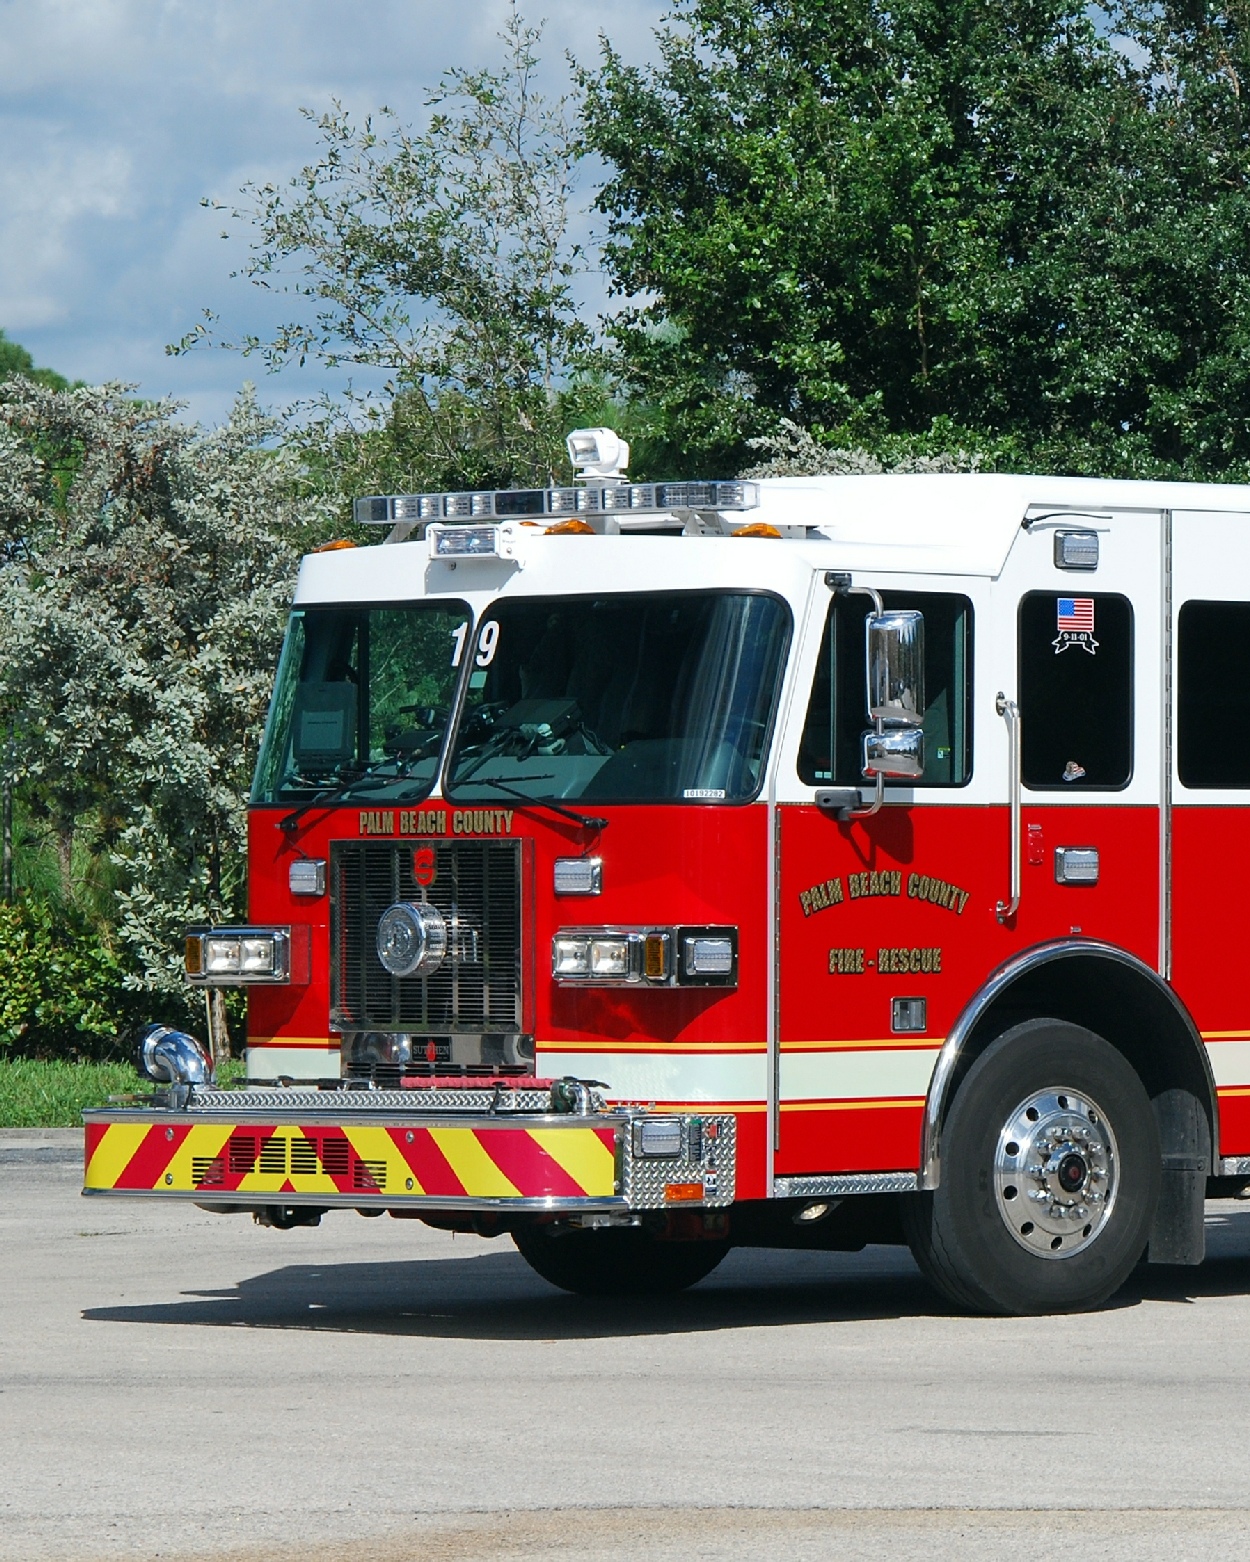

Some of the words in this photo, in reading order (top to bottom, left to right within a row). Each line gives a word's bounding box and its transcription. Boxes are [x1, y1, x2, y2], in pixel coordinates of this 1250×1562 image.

[451, 621, 500, 667] 19
[359, 811, 394, 835] PALM
[400, 810, 446, 834] BEACH
[453, 809, 514, 834] COUNTY
[799, 877, 844, 917] PALM
[848, 870, 902, 898] BEACH
[907, 872, 970, 915] COUNTY
[828, 948, 865, 974] FIRE
[877, 947, 942, 973] RESCUE
